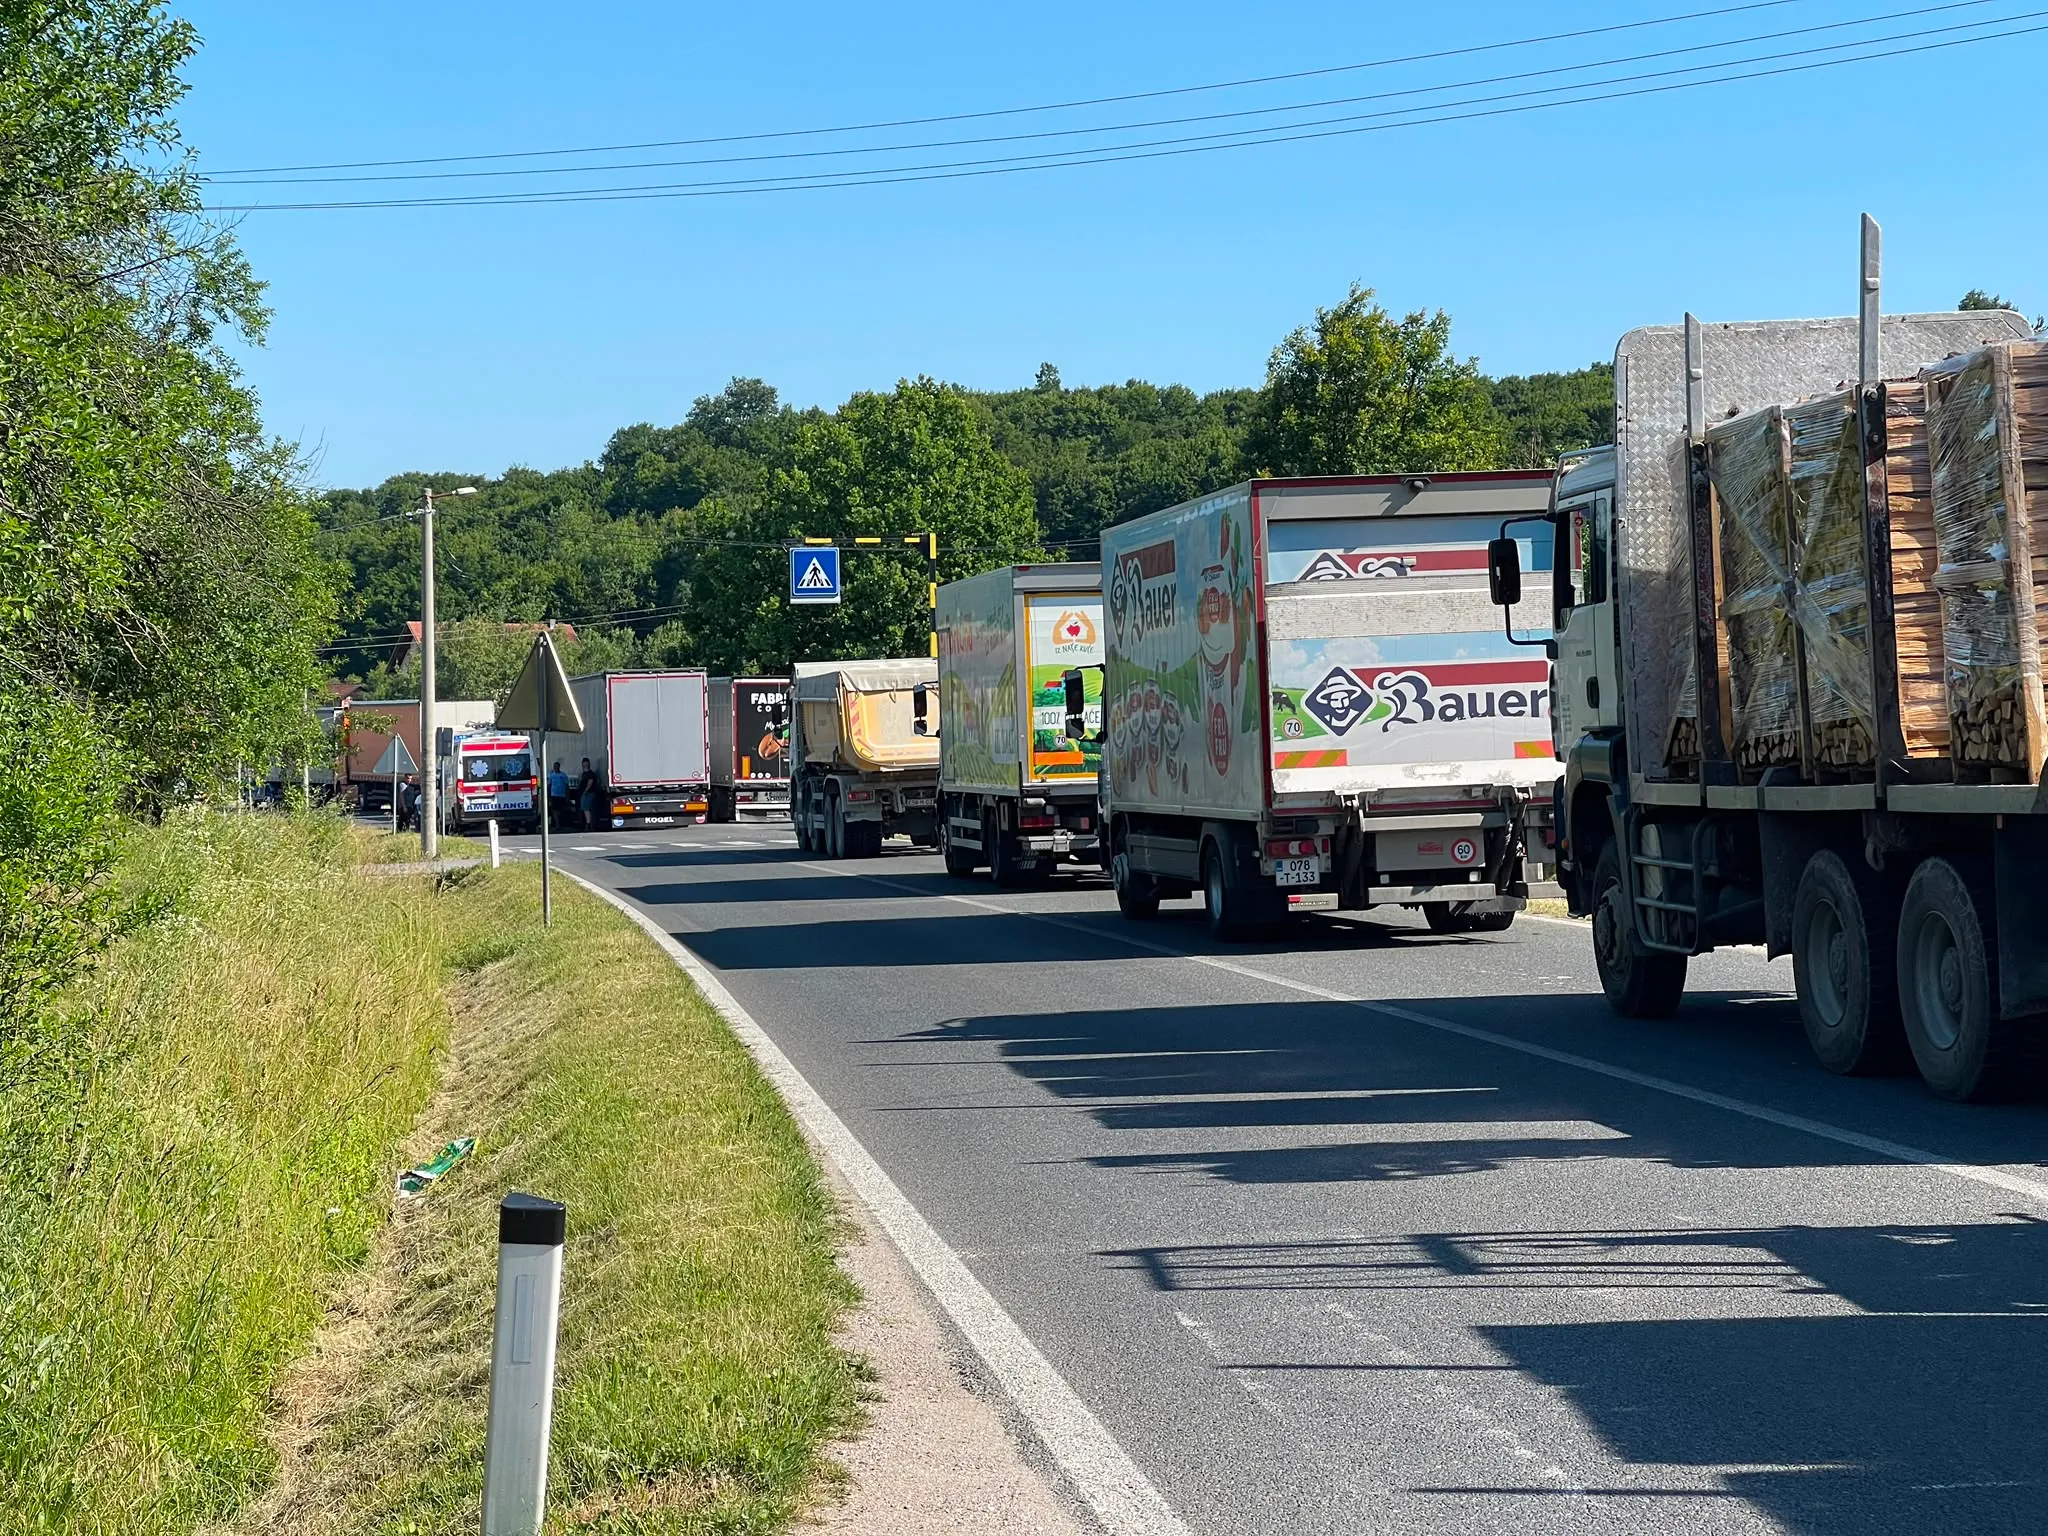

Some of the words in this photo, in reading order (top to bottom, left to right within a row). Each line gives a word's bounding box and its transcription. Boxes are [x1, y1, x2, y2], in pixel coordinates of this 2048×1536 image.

[1127, 558, 1177, 646] Bauer
[1377, 674, 1548, 733] Bauer
[1286, 722, 1300, 733] 70
[1056, 736, 1066, 744] 70
[466, 802, 530, 811] AMBULANCE
[1457, 844, 1470, 855] 60
[1289, 860, 1311, 872] 078
